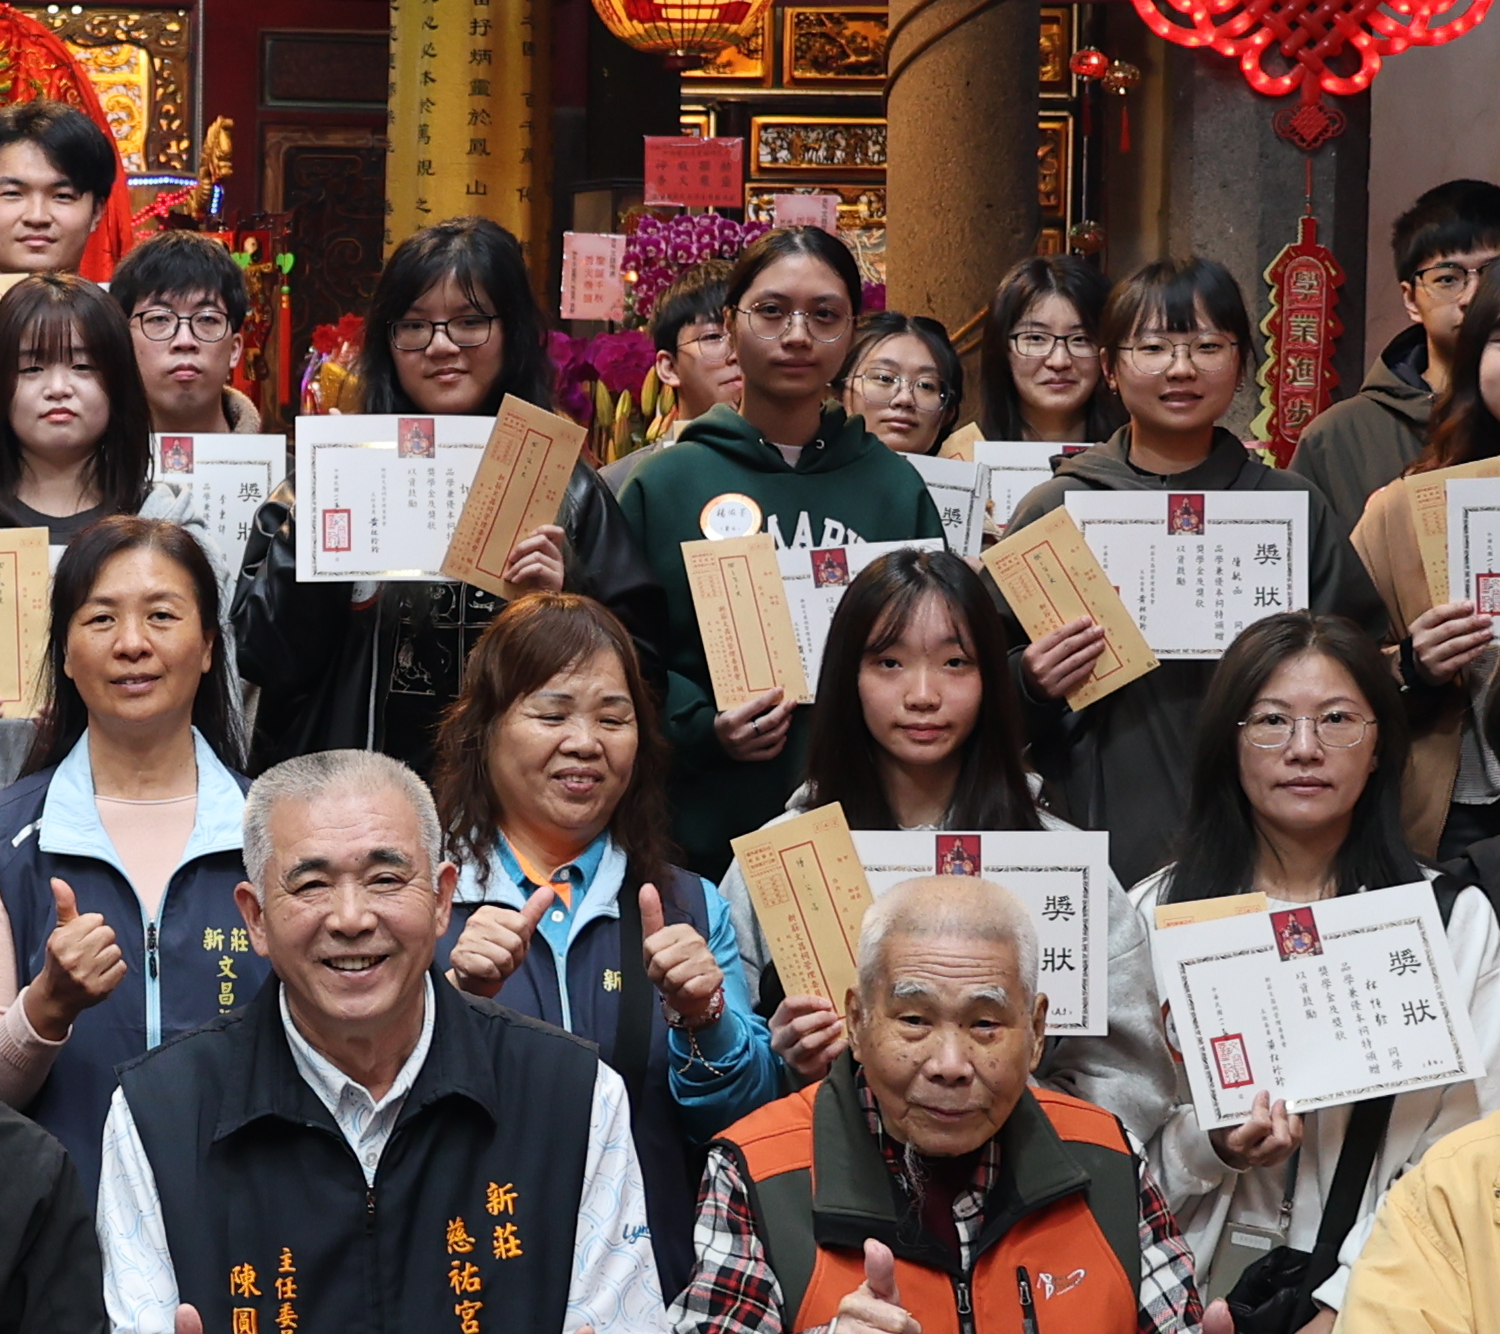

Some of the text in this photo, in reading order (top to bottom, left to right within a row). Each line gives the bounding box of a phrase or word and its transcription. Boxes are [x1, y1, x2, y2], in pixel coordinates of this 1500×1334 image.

[1286, 270, 1321, 428] 學業進步
[1253, 543, 1283, 608] 獎狀
[202, 927, 250, 953] 新莊
[1040, 895, 1076, 974] 獎狀
[216, 955, 238, 1015] 文昌
[1318, 966, 1347, 1041] 獎學金及獎狀
[1339, 962, 1381, 1075] 品學兼優本祠特頒贈
[1389, 948, 1437, 1027] 獎狀
[485, 1181, 524, 1260] 新莊
